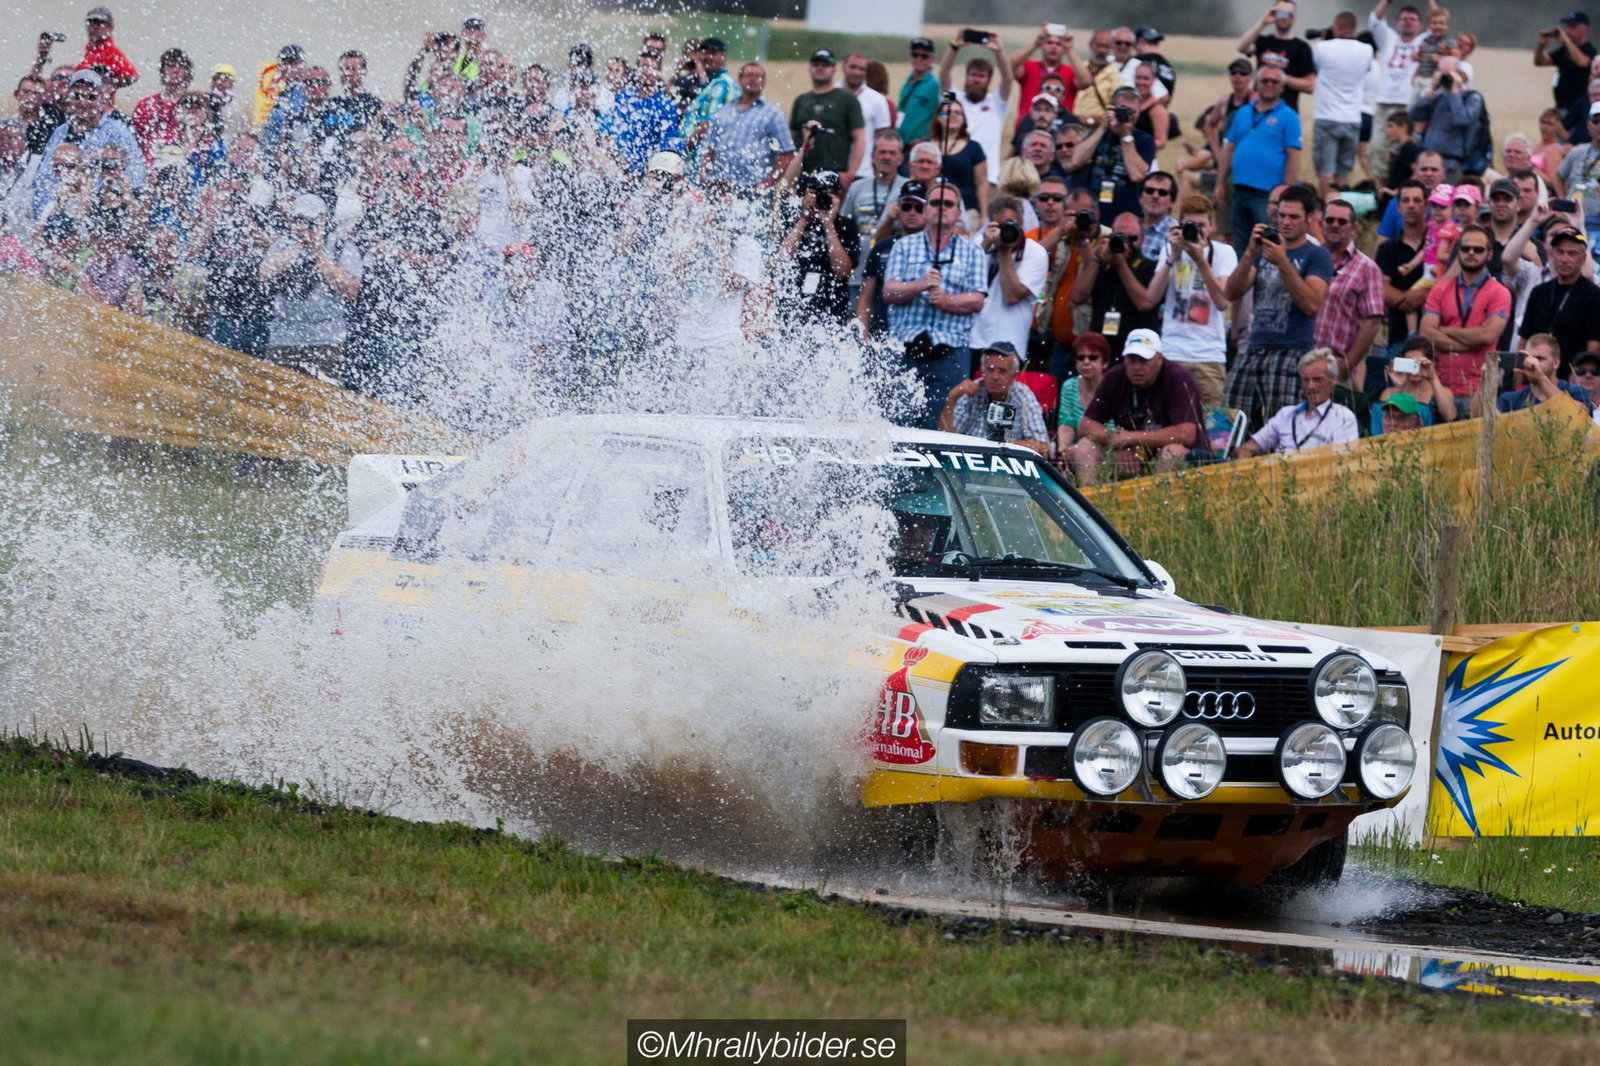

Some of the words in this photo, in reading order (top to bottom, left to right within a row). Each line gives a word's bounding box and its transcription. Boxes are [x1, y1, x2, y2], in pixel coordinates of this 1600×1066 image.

[941, 451, 1040, 478] TEAM
[1172, 651, 1278, 662] CHELIN
[1543, 722, 1600, 740] Auto
